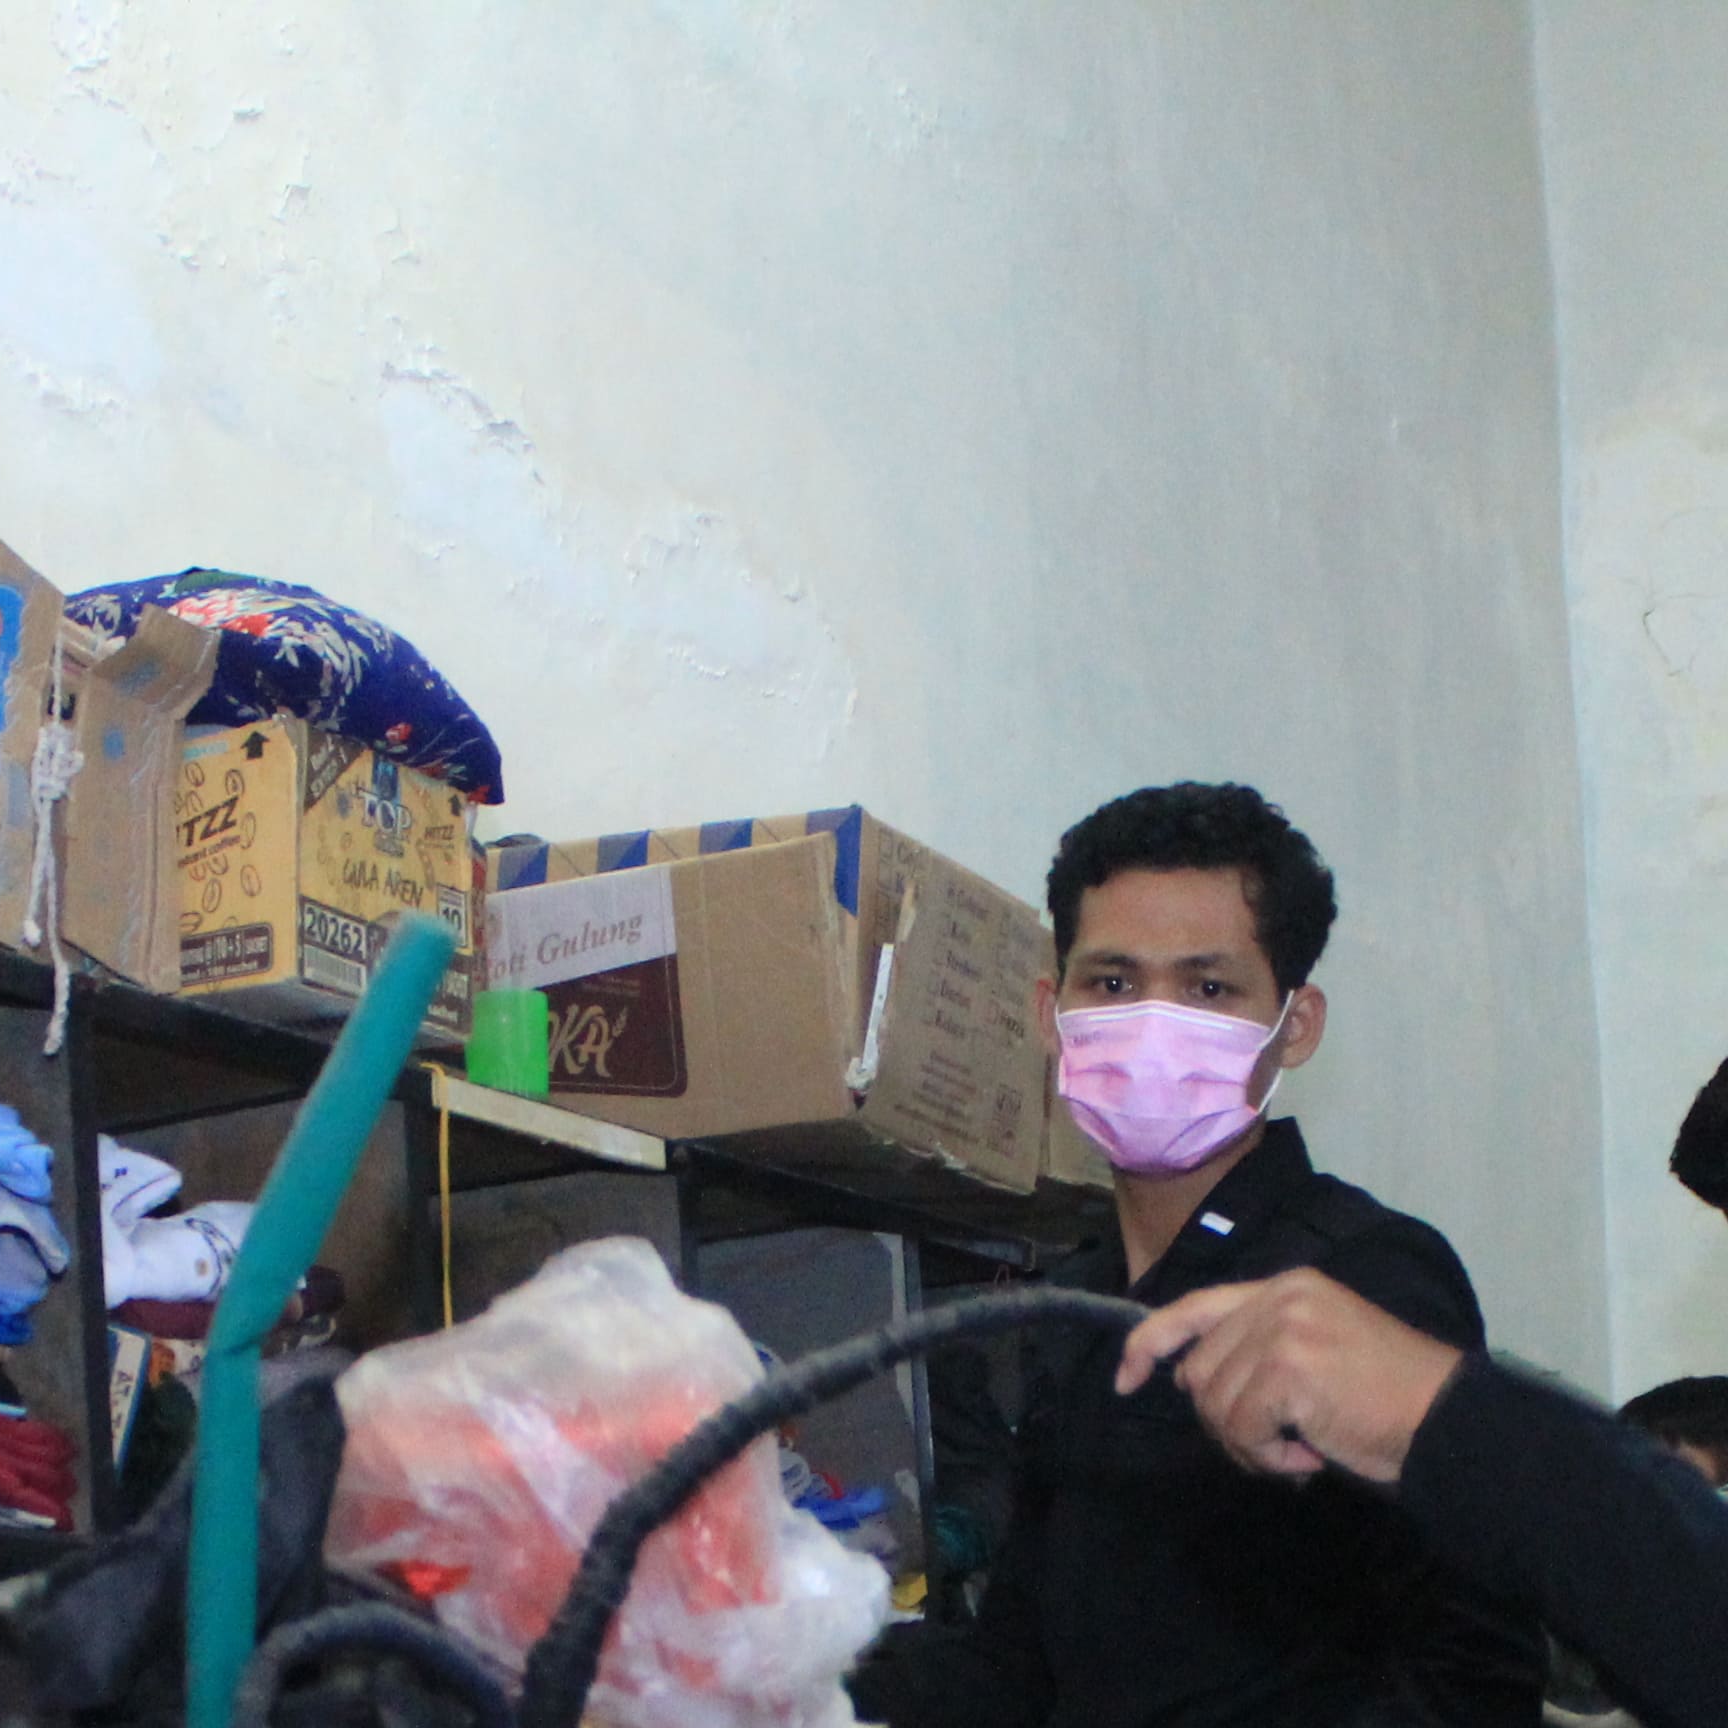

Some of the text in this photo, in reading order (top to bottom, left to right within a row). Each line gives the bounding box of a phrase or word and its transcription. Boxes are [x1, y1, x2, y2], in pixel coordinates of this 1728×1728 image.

[305, 905, 364, 960] 20262
[485, 914, 643, 983] oti Gulung
